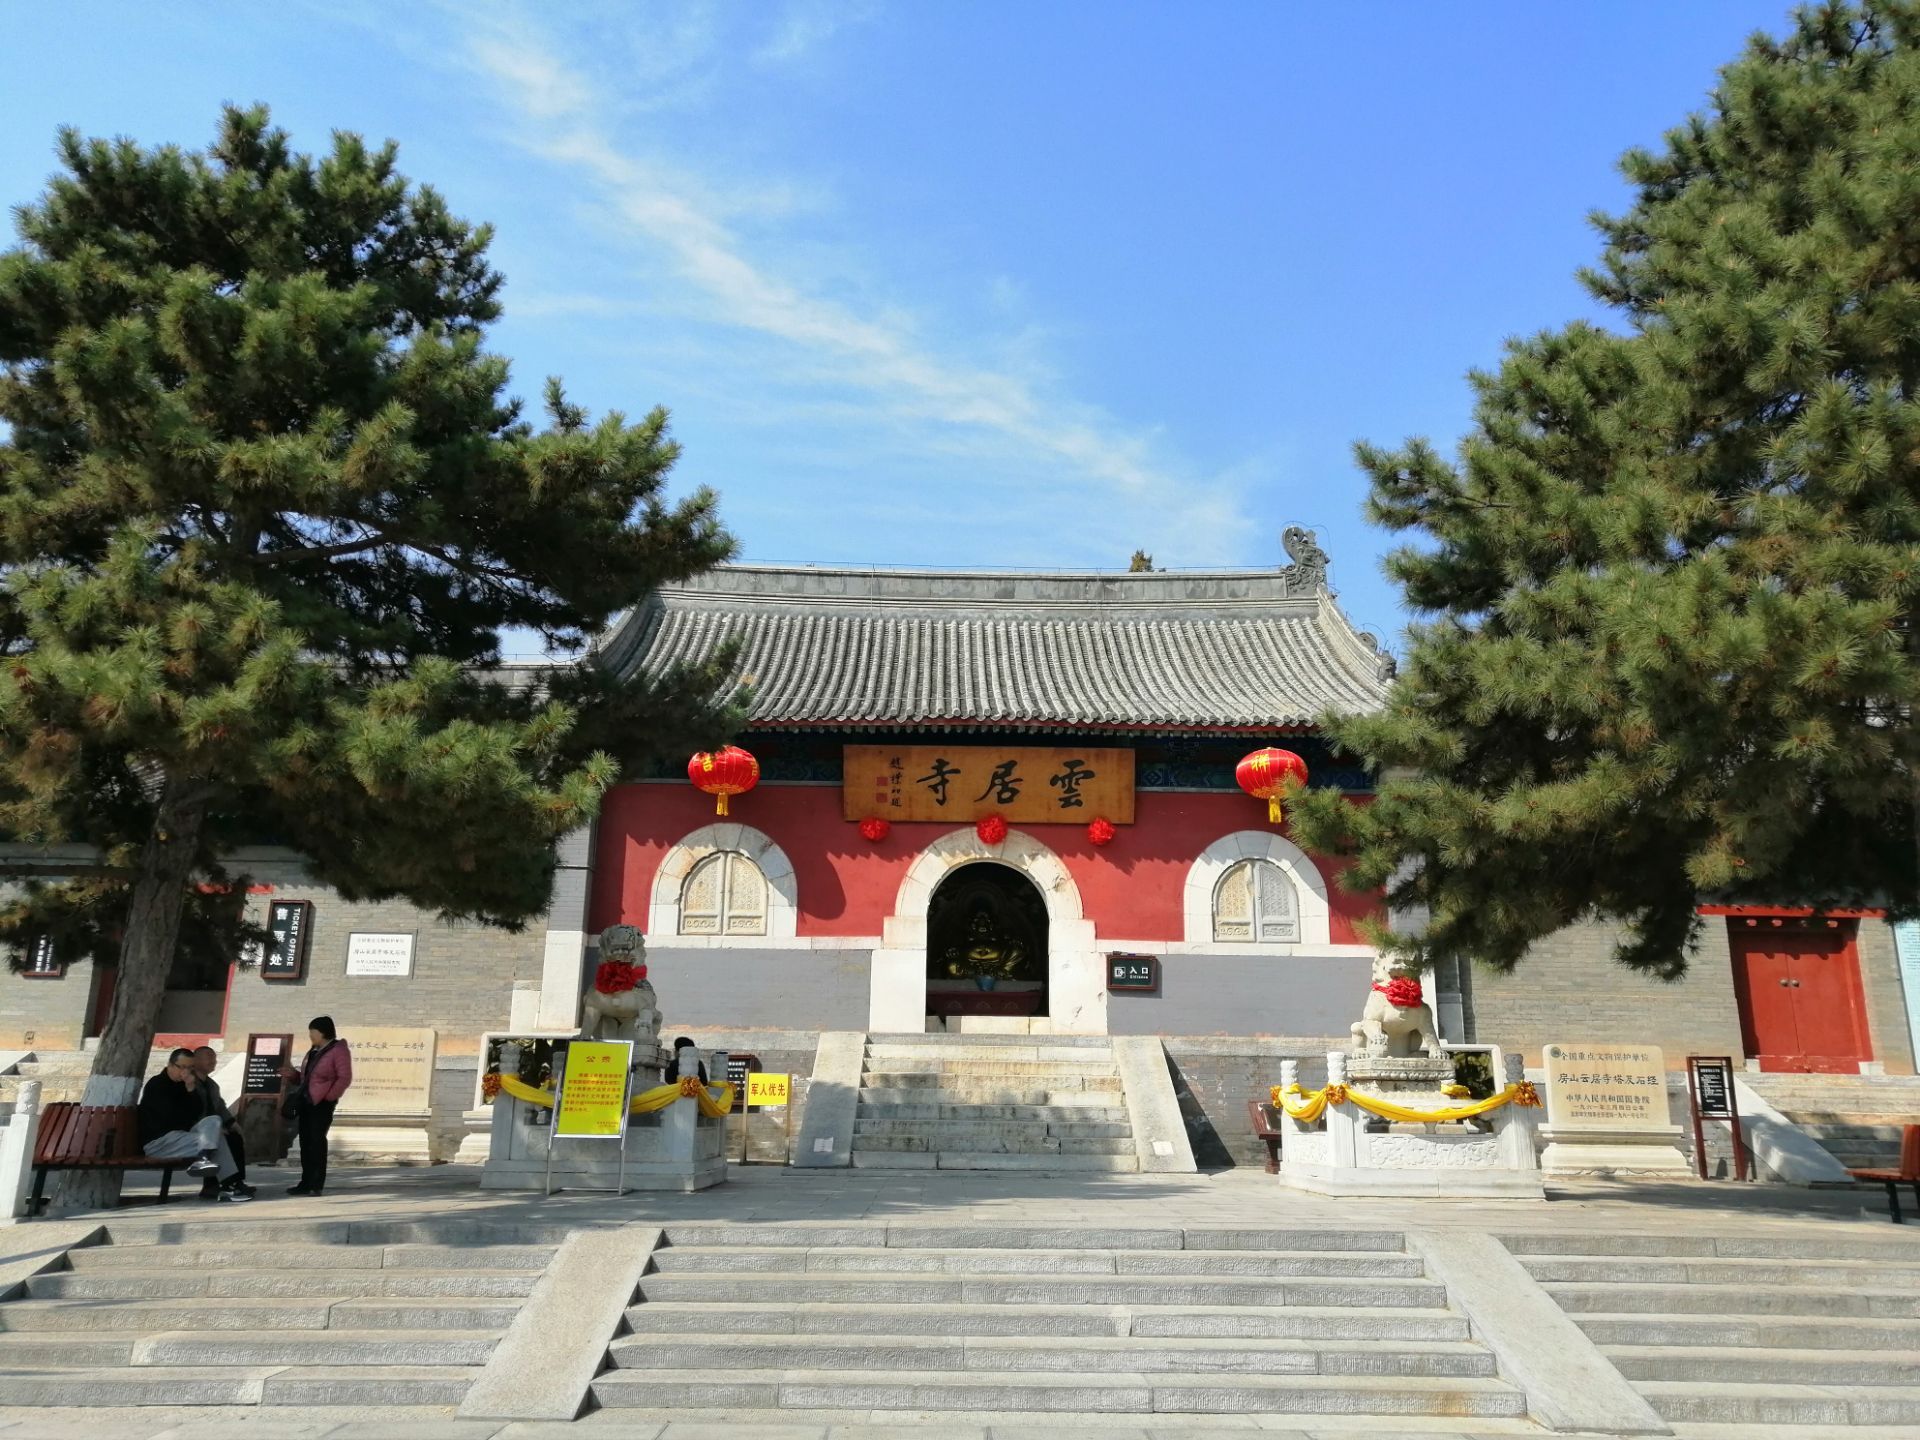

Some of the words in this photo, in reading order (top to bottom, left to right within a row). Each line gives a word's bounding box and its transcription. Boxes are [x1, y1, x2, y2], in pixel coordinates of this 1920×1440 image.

[290, 908, 301, 936] TICKET
[269, 907, 289, 966] 售票处
[286, 938, 297, 967] OFFICE
[1129, 966, 1149, 975] 入口
[1560, 1051, 1649, 1062] 全国重点文物保护单位
[1558, 1073, 1660, 1086] 房山云居寺塔及石经
[751, 1083, 786, 1097] 军人优先
